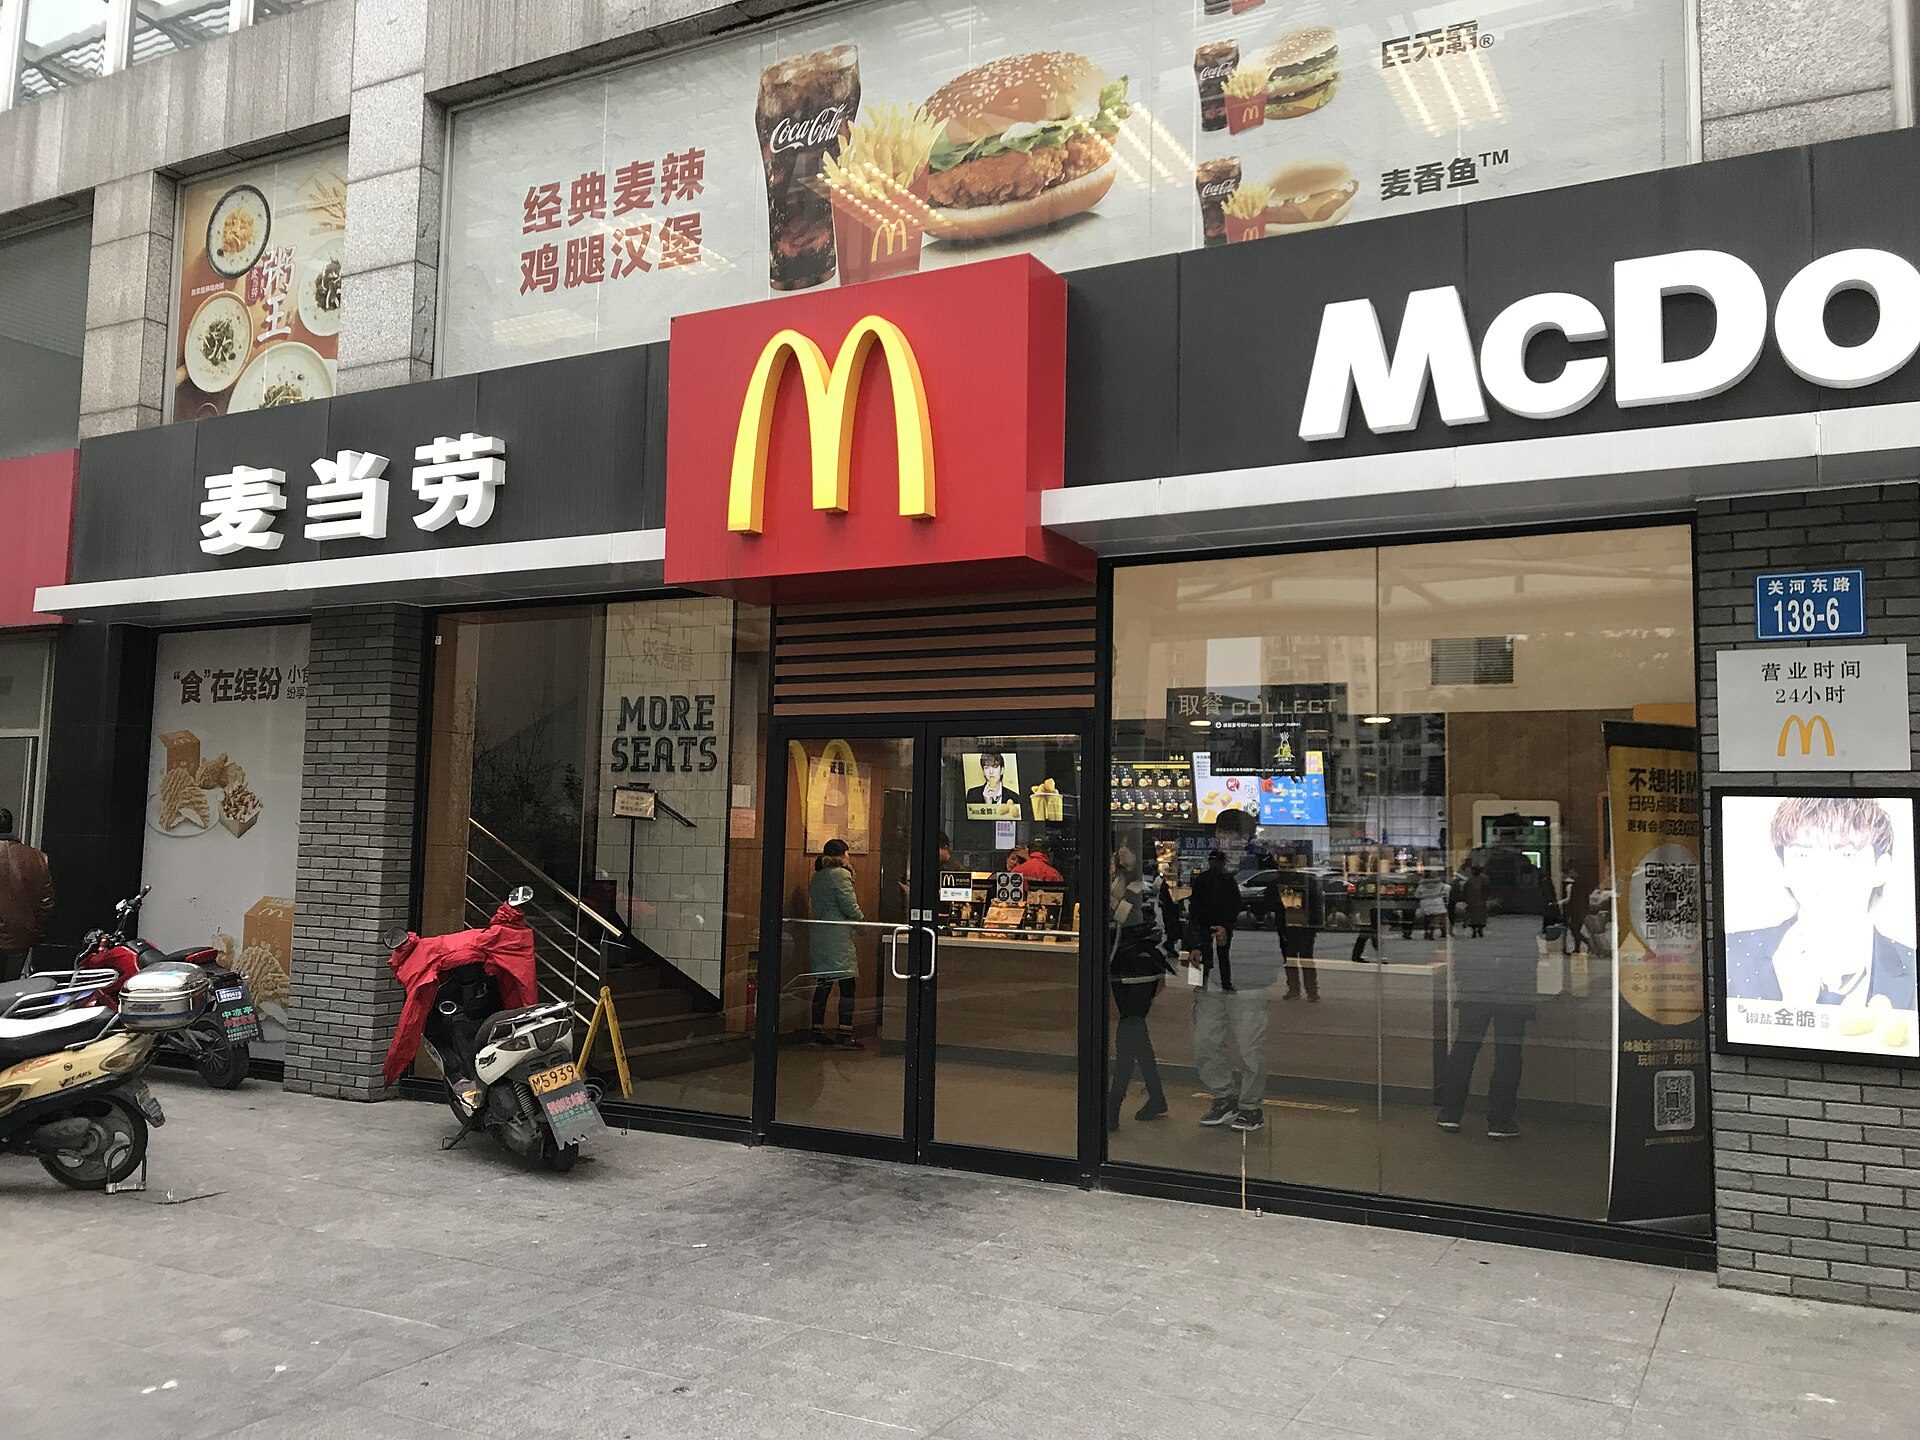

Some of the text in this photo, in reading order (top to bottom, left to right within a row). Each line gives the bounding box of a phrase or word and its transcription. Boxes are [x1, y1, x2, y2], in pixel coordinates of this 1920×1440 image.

[770, 103, 848, 153] Coca-Cola
[521, 147, 706, 236] 经典麦辣
[519, 212, 704, 297] 鸡腿汉堡
[199, 432, 506, 556] 麦当劳
[1767, 577, 1851, 596] 关河东路
[1773, 597, 1840, 633] 138-6
[173, 666, 282, 705] “食”在缤纷
[1761, 660, 1861, 682] 营业时间
[286, 686, 308, 700] 纷享
[1177, 693, 1337, 717] 取餐 COLLECT
[1775, 685, 1846, 705] 24小时
[616, 694, 715, 732] MORE
[610, 736, 718, 773] SEATS
